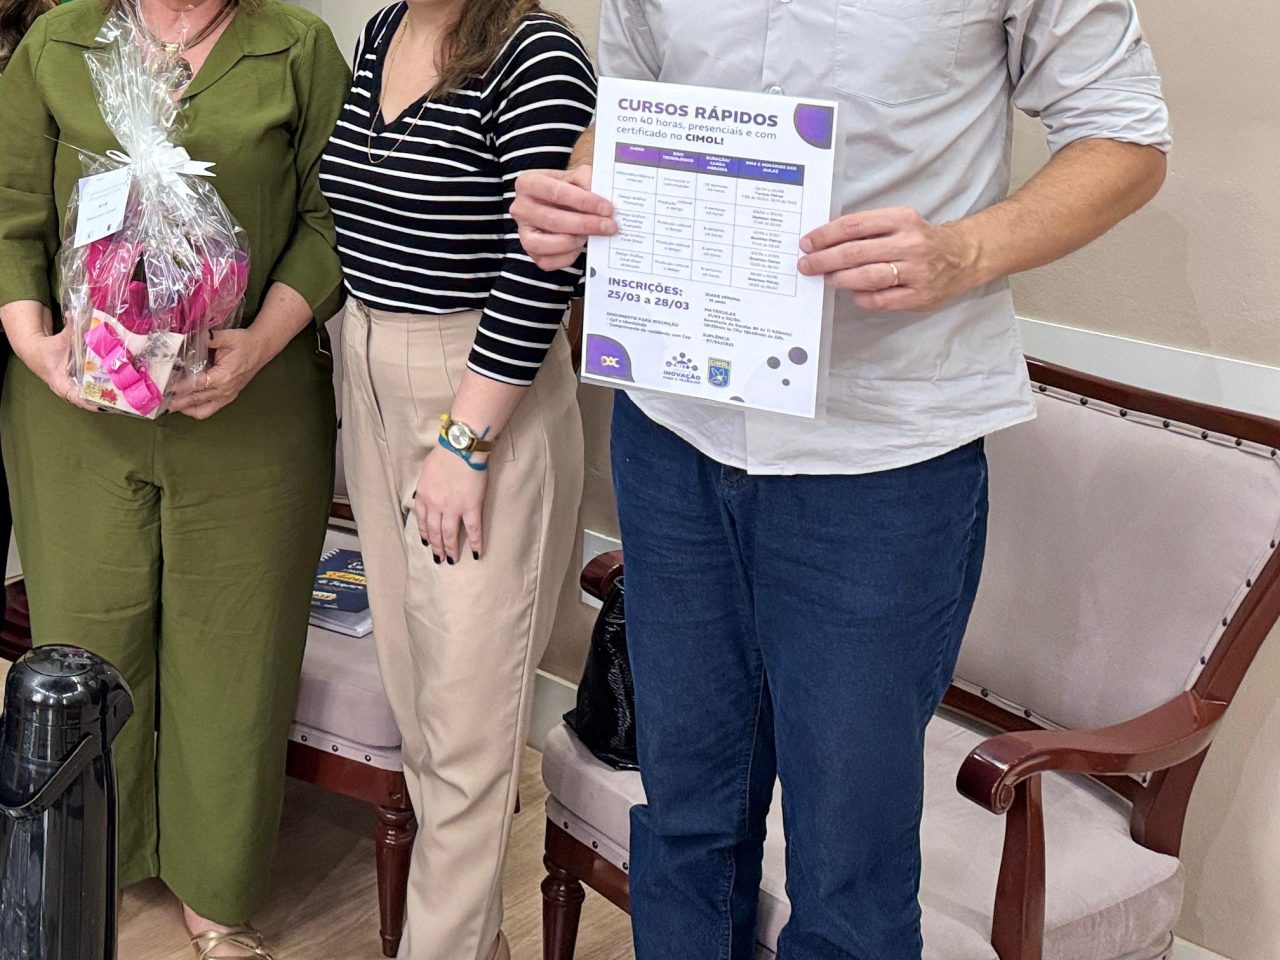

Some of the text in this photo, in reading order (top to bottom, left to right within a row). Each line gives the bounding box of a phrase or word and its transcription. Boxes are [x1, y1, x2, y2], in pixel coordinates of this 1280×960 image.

[617, 98, 779, 127] CURSOS RÁPIDOS
[616, 125, 724, 145] certificado no CIMOL!
[617, 114, 637, 124] com
[640, 116, 653, 126] 40
[656, 116, 686, 130] horas,
[688, 122, 743, 137] presenciais
[755, 130, 777, 140] com
[608, 277, 683, 296] INSCRIÇÕES:
[607, 290, 641, 303] 25/03
[654, 297, 690, 310] 28/03
[663, 370, 701, 381] INOVAÇÃO
